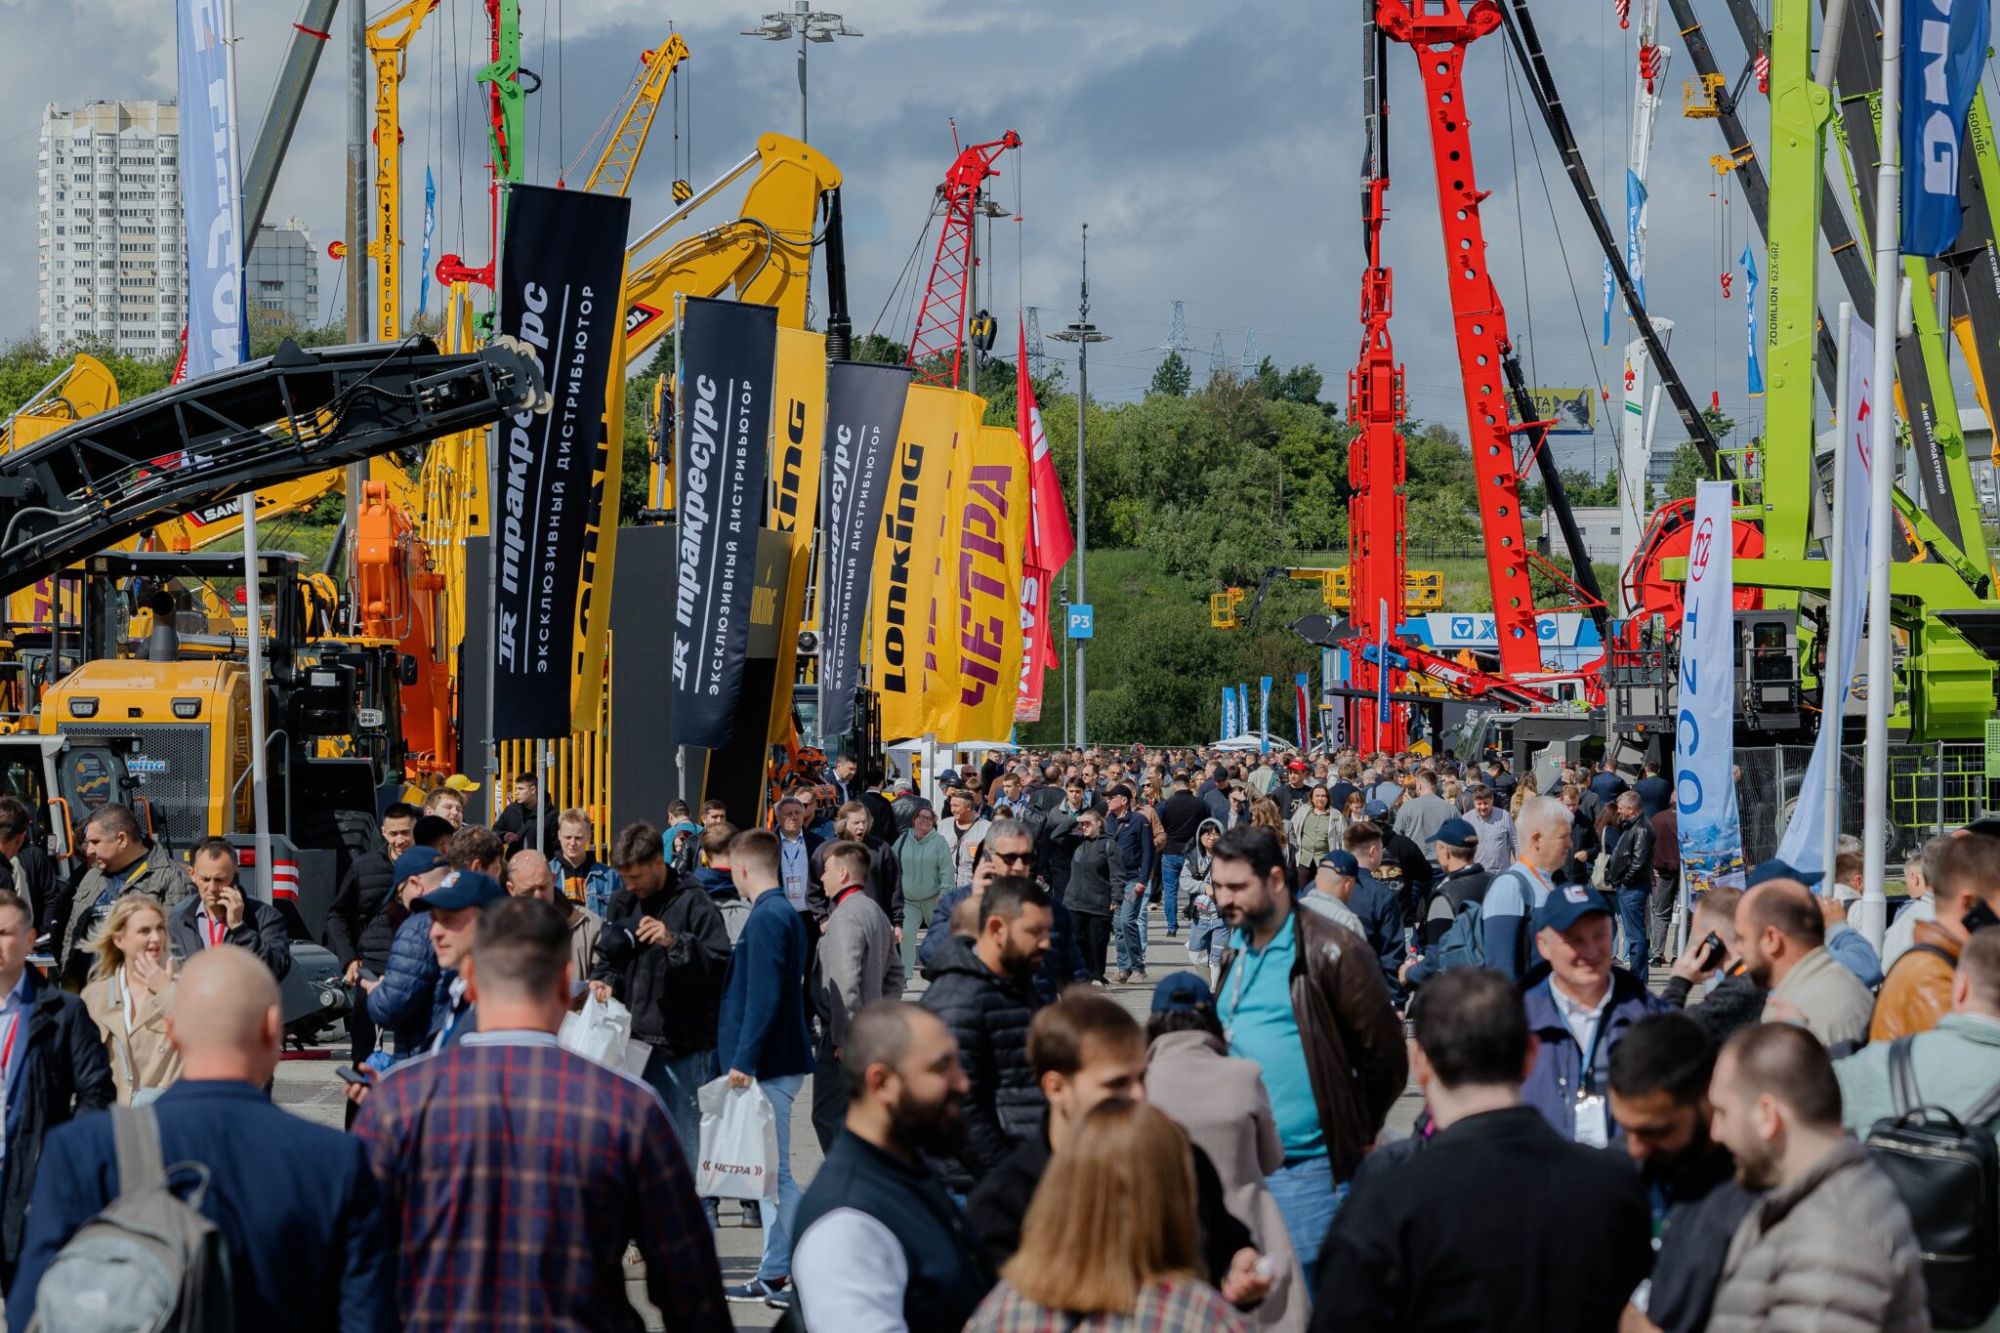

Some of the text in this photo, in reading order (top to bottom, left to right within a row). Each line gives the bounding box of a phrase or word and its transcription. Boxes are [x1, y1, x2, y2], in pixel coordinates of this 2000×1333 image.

[1769, 241, 1779, 346] ZOOMLION 62X-6RZ
[537, 481, 566, 673] ЭКСКЛЮЗИВНЫЙ
[557, 285, 594, 471] ДИСТРИБЬЮТОР
[1930, 442, 1938, 460] ПОД
[1933, 460, 1946, 494] СТРЕЛОЙ
[204, 500, 240, 522] SAN
[708, 380, 752, 696] ЭКСКЛЮЗИВНЫЙ ДИСТРИБЬЮТОР
[835, 425, 880, 690] ЭКСКЛЮЗИВНЫЙ ДИСТРИБЬЮТОР
[959, 465, 1013, 708] ЧЕТРА
[1070, 614, 1090, 629] P3
[1677, 596, 1703, 815] TZCO
[714, 1162, 751, 1175] ЧЕТРА
